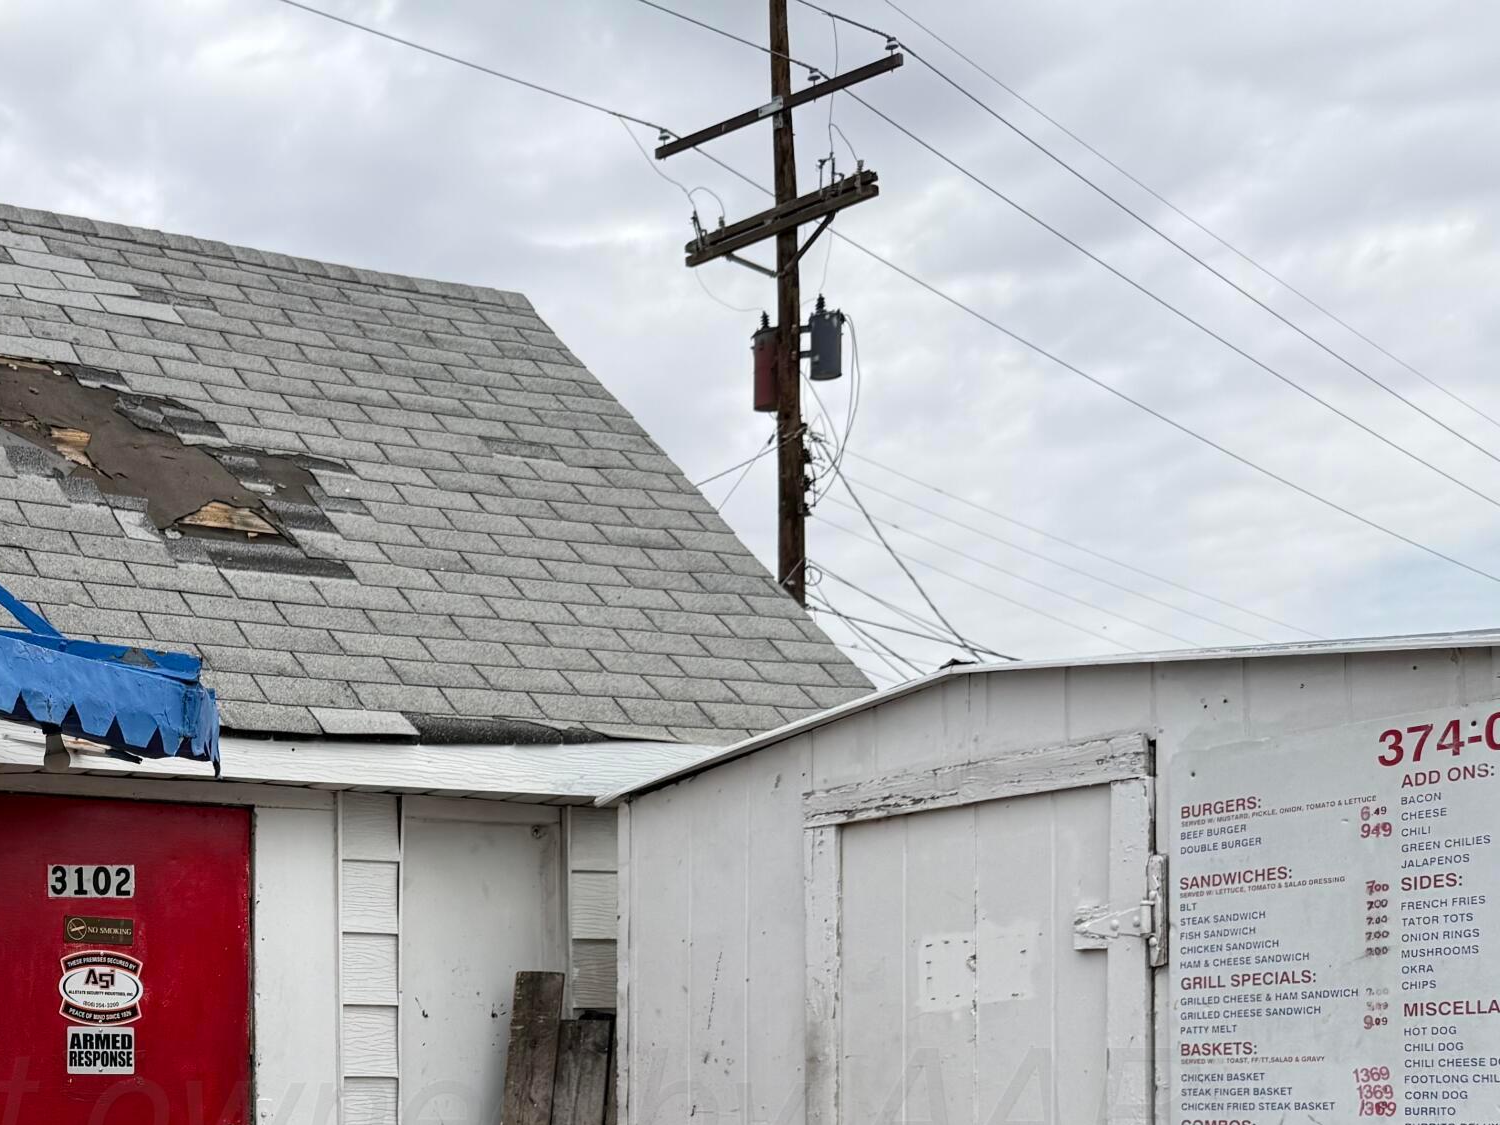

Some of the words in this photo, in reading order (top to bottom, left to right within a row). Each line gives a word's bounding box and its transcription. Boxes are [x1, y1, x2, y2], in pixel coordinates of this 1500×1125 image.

[1401, 771, 1441, 788] ADD
[1447, 763, 1495, 781] ONS:
[1401, 792, 1442, 806] BACON
[1181, 796, 1261, 819] BURGERS:
[1181, 819, 1205, 827] SERVED
[1306, 801, 1335, 811] TOMATO
[1344, 795, 1376, 805] LETTUCE
[1401, 808, 1447, 821] CHEESE
[1181, 827, 1207, 840] BEEF
[1206, 824, 1247, 837] BURGER
[1401, 826, 1431, 836] CHILI
[1181, 842, 1219, 854] DOUBLE
[1221, 838, 1261, 850] BURGER
[1401, 841, 1441, 853] GREEN
[1445, 835, 1491, 848] CHILIES
[1401, 854, 1470, 869] JALAPENOS
[51, 865, 131, 896] 3102
[1180, 867, 1292, 890] SANDWICHES:
[1248, 884, 1275, 892] TOMATO
[1284, 880, 1307, 888] SALAD
[1309, 876, 1345, 886] DRESSING
[1401, 873, 1463, 892] SIDES:
[1180, 902, 1197, 912] BLT
[1401, 899, 1448, 910] FRENCH
[1452, 896, 1486, 907] FRIES
[1180, 916, 1211, 926] STEAK
[1214, 911, 1266, 923] SANDWICH
[1402, 915, 1439, 926] TATOR
[1443, 913, 1474, 924] TOTS
[1180, 931, 1202, 940] FISH
[1205, 927, 1256, 938] SANDWICH
[1401, 932, 1439, 943] ONION
[1443, 929, 1480, 940] RINGS
[1180, 944, 1223, 955] CHICKEN
[1226, 939, 1279, 952] SANDWICH
[1401, 945, 1480, 958] MUSHROOMS
[68, 959, 82, 967] THESE
[107, 958, 128, 967] SECURED
[1180, 960, 1201, 969] HAM
[1204, 958, 1210, 968] &
[1213, 955, 1252, 967] CHEESE
[1256, 951, 1310, 964] SANDWICH
[1402, 965, 1434, 974] OKRA
[1181, 976, 1226, 990] GRILL
[1231, 970, 1317, 988] SPECIALS:
[1402, 980, 1436, 990] CHIPS
[1181, 995, 1219, 1006] GRILLED
[1223, 992, 1261, 1004] CHEESE
[1265, 992, 1272, 1001] &
[1275, 990, 1298, 1000] HAM
[1301, 988, 1359, 1000] SANDWICH
[68, 1008, 85, 1018] PEACE
[1181, 1011, 1220, 1021] GRILLED
[1223, 1008, 1262, 1019] CHEESE
[1265, 1005, 1321, 1017] SANDWICH
[1180, 1026, 1208, 1035] PATTY
[1212, 1024, 1237, 1033] MELT
[1404, 1027, 1427, 1036] HOT
[1431, 1027, 1457, 1035] DOG
[70, 1033, 133, 1050] ARMED
[1404, 1043, 1434, 1052] CHILI
[1438, 1042, 1464, 1051] DOG
[1181, 1042, 1258, 1056] BASKETS:
[69, 1051, 133, 1067] RESPONSE
[1404, 1059, 1434, 1068] CHILI
[1439, 1058, 1486, 1067] CHEESE
[1181, 1073, 1224, 1082] CHICKEN
[1227, 1073, 1265, 1081] BASKET
[1404, 1075, 1469, 1084] FOOTLONG
[1181, 1088, 1211, 1096] STEAK
[1214, 1088, 1250, 1096] FINGER
[1253, 1087, 1292, 1095] BASKET
[1405, 1091, 1438, 1100] CORN
[1442, 1091, 1468, 1100] DOG
[1181, 1102, 1224, 1111] CHICKEN
[1227, 1102, 1256, 1110] FRIED
[1259, 1102, 1291, 1110] STEAK
[1294, 1102, 1335, 1110] BASKET
[1405, 1107, 1456, 1116] BURRITO
